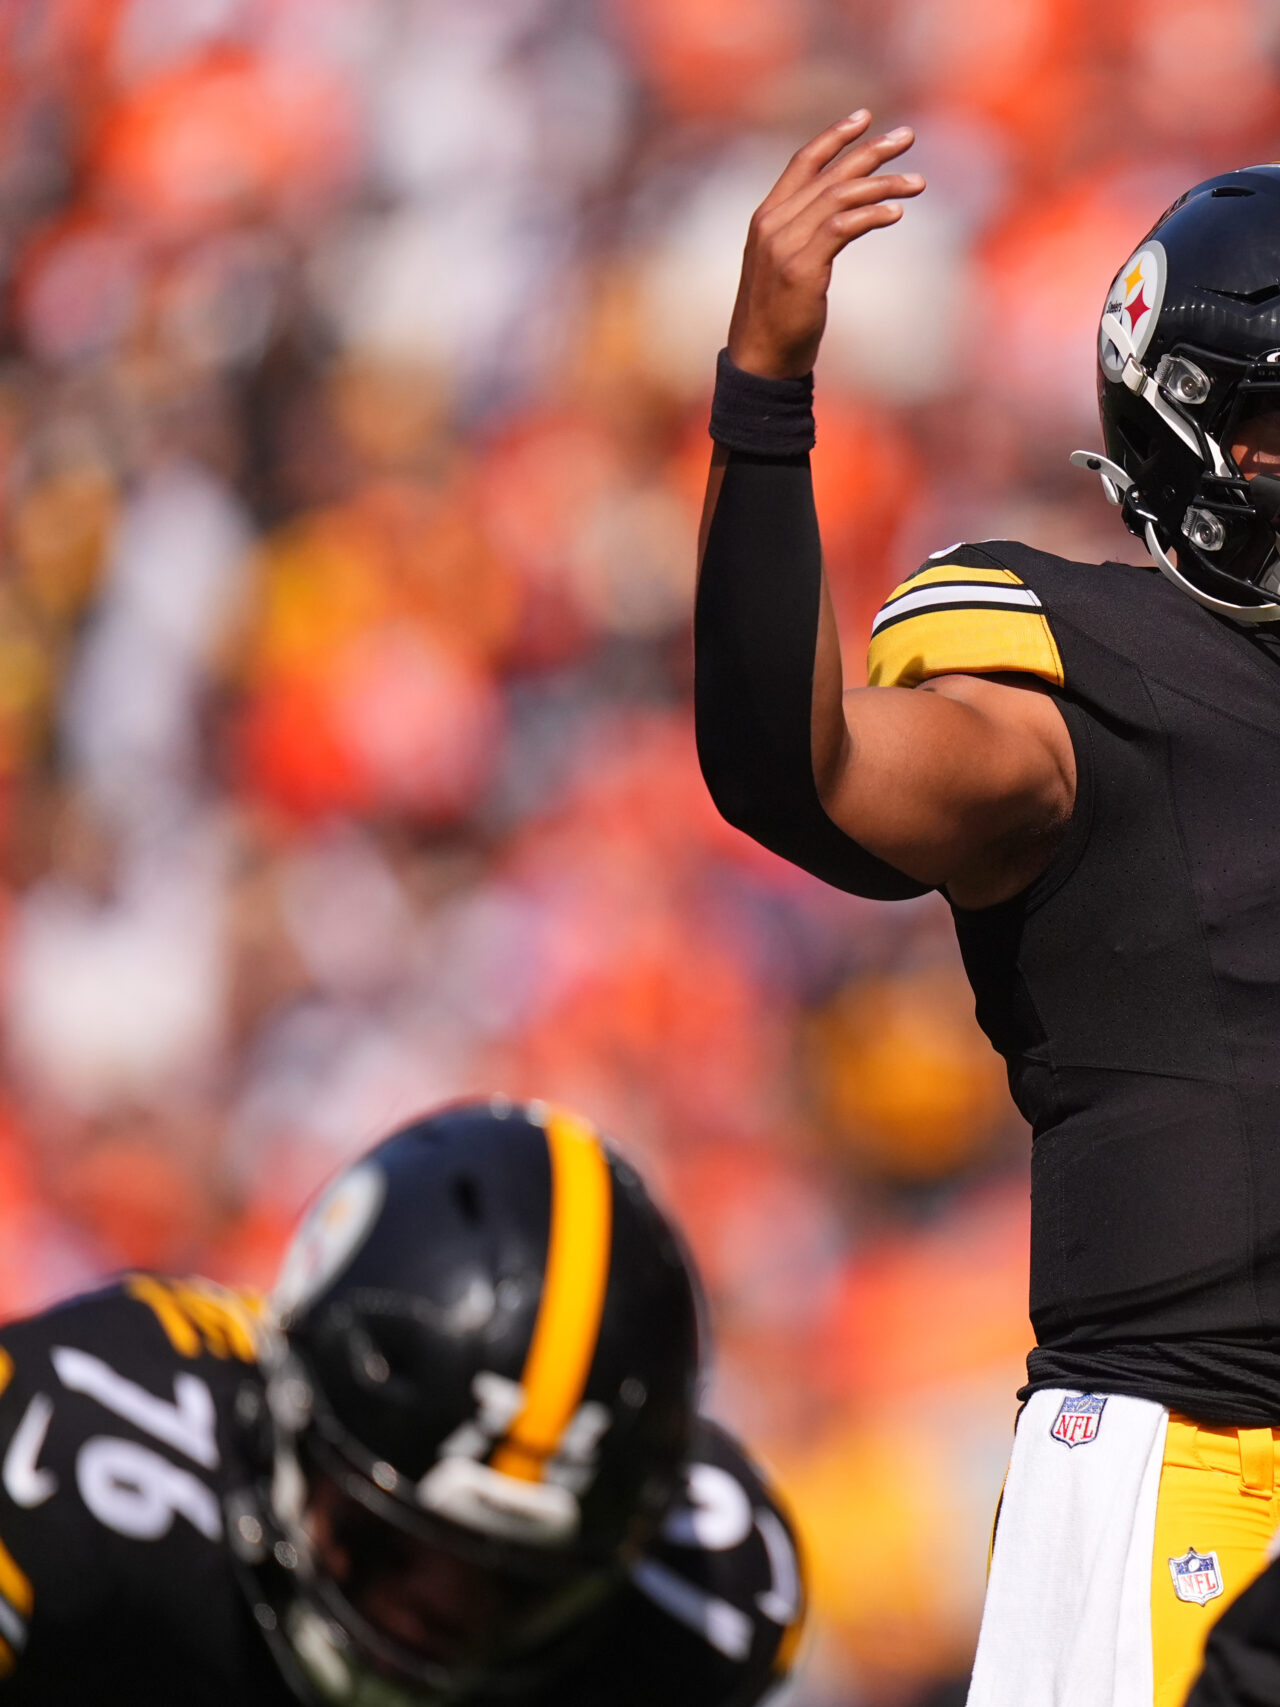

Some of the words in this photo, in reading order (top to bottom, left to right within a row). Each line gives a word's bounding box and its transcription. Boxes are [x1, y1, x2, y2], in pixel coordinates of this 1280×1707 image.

[1055, 1414, 1093, 1441] NFL
[52, 1347, 222, 1541] 76
[1181, 1572, 1216, 1594] NFL
